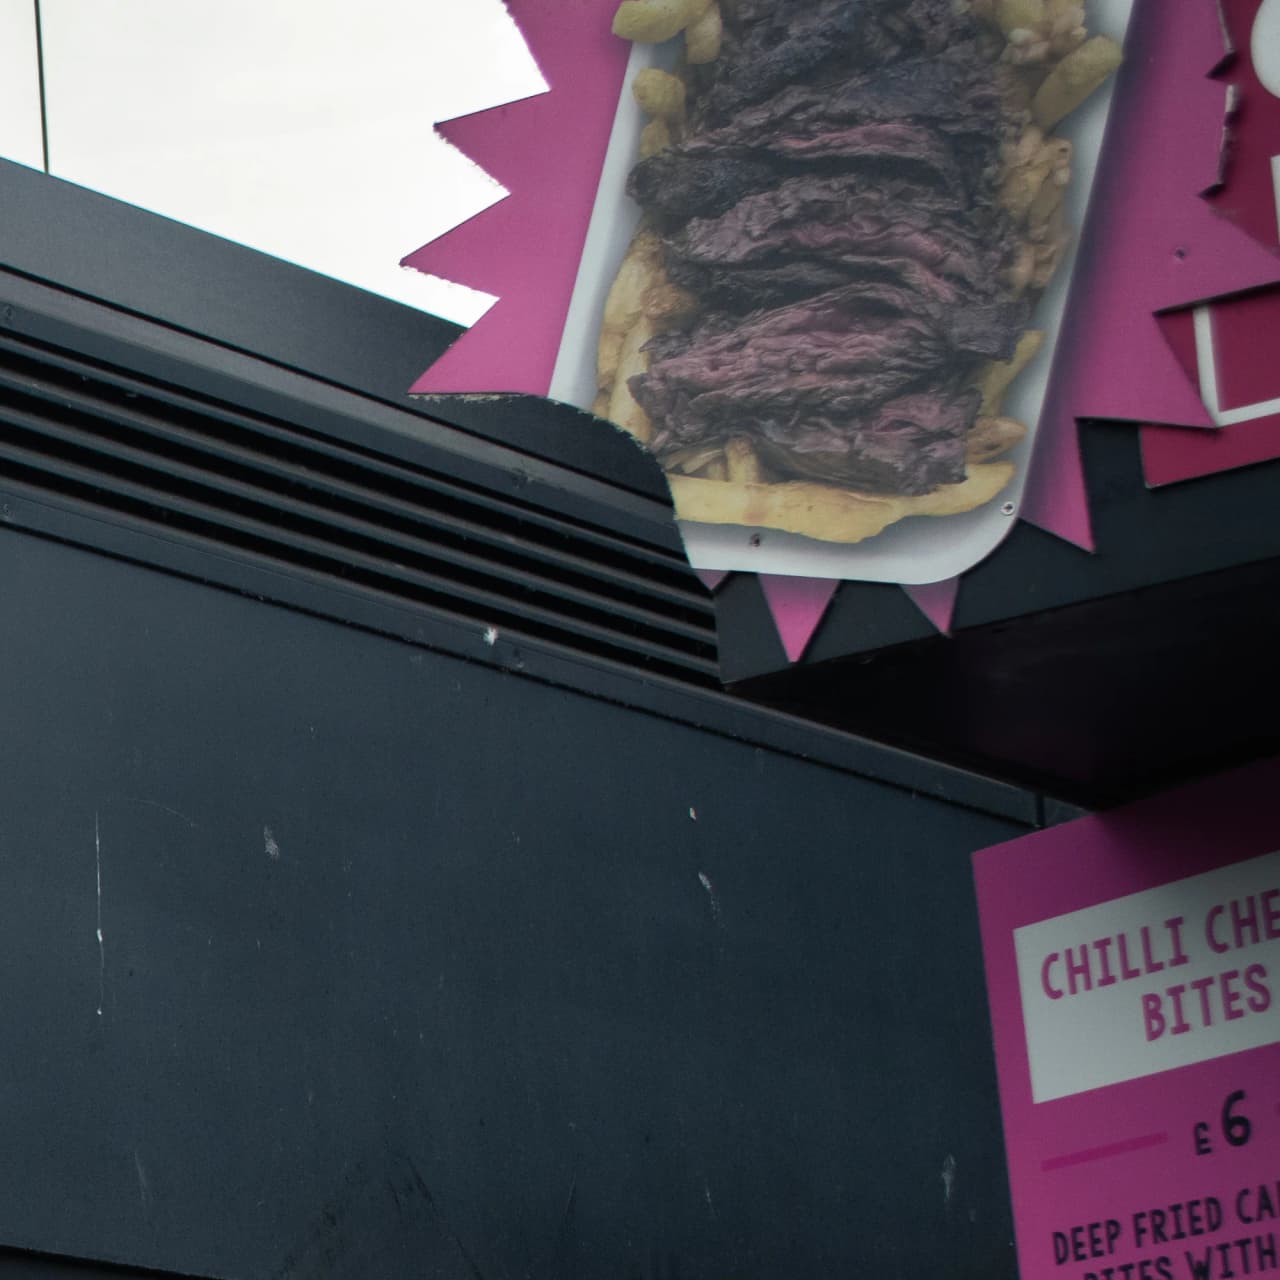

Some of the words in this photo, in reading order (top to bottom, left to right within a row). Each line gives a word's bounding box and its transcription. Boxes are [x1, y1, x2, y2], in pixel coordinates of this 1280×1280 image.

[1041, 916, 1189, 1001] CHILLI
[1142, 964, 1272, 1043] BITES
[1193, 1090, 1252, 1157] £6
[1052, 1218, 1122, 1266] DEEP
[1132, 1196, 1223, 1250] FRIED
